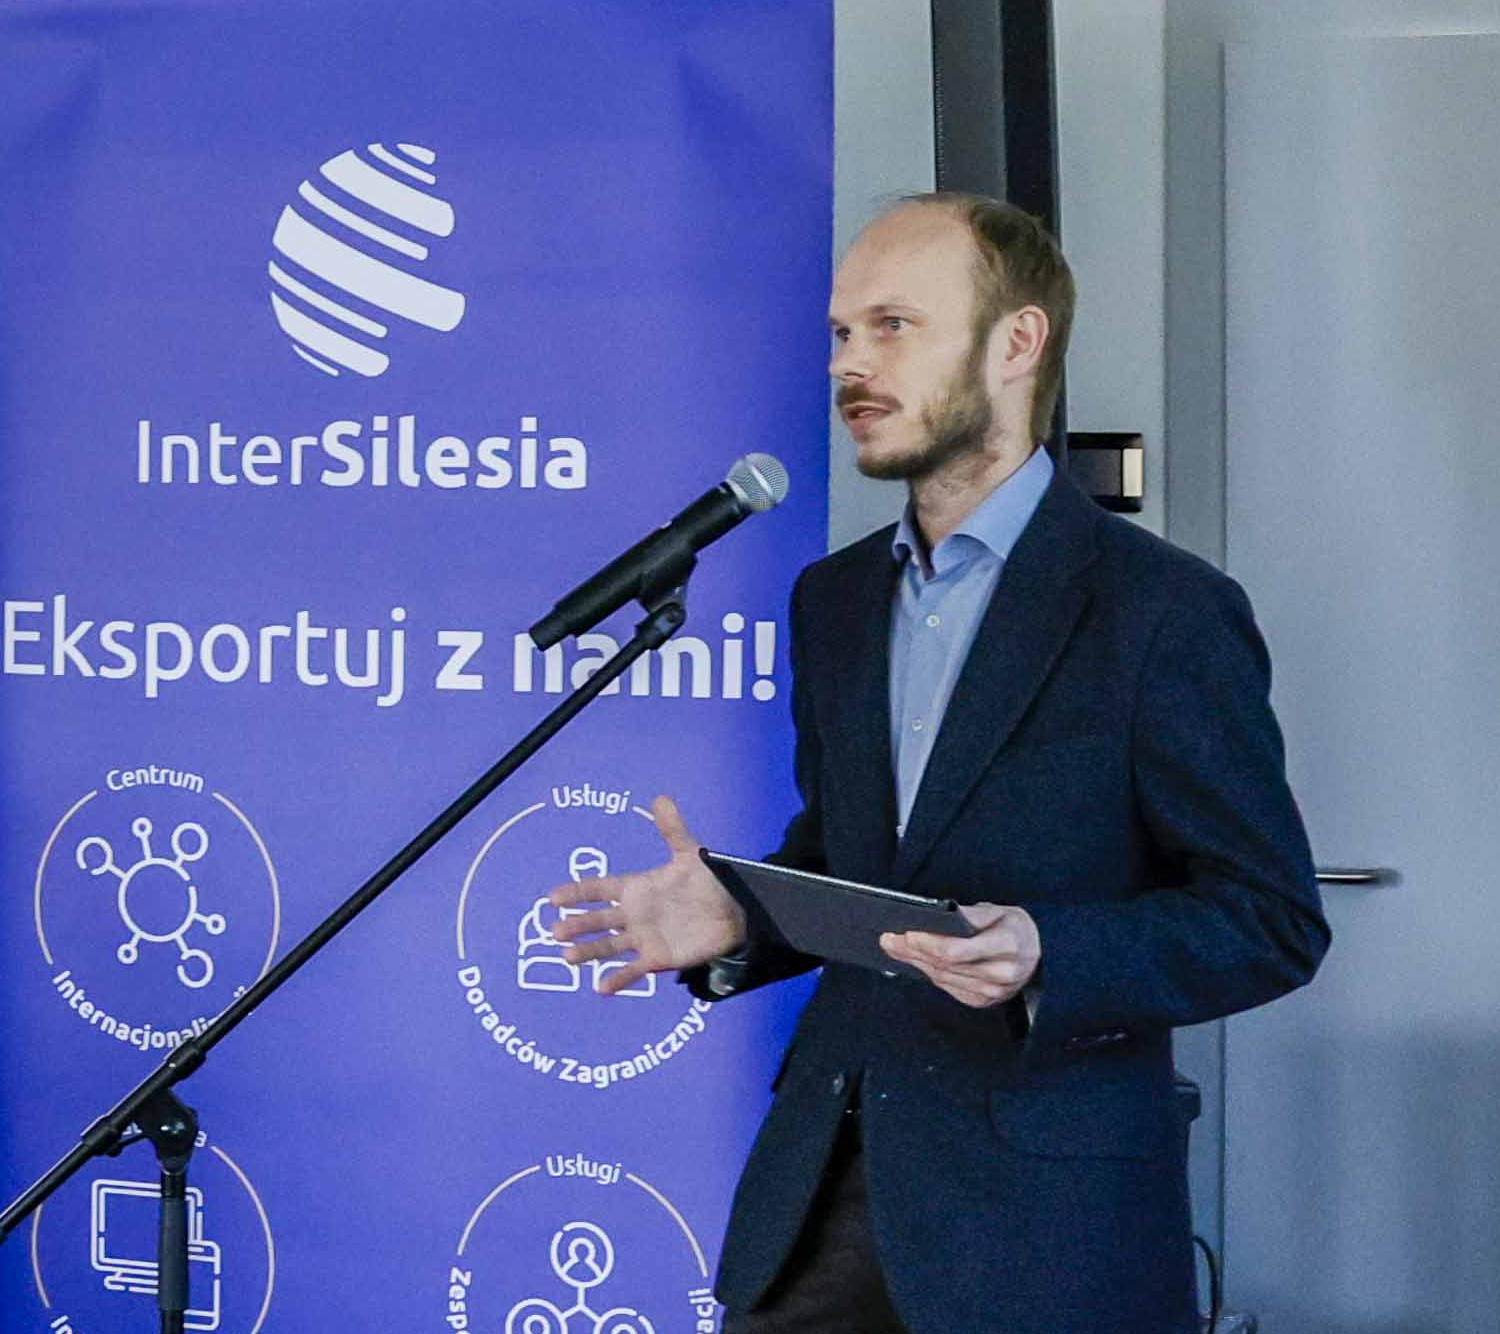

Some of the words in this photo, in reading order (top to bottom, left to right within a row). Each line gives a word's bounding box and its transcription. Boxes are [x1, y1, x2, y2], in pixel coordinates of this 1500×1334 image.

[137, 414, 588, 490] InterSilesia
[3, 594, 406, 707] Eksportuj
[435, 630, 484, 691] z
[513, 612, 776, 701] nami!
[106, 765, 204, 793] Centrum
[551, 783, 631, 815] Usługi
[458, 966, 555, 1074] Doradców
[558, 998, 712, 1088] Zagranicznyc
[546, 1153, 622, 1185] Usługi
